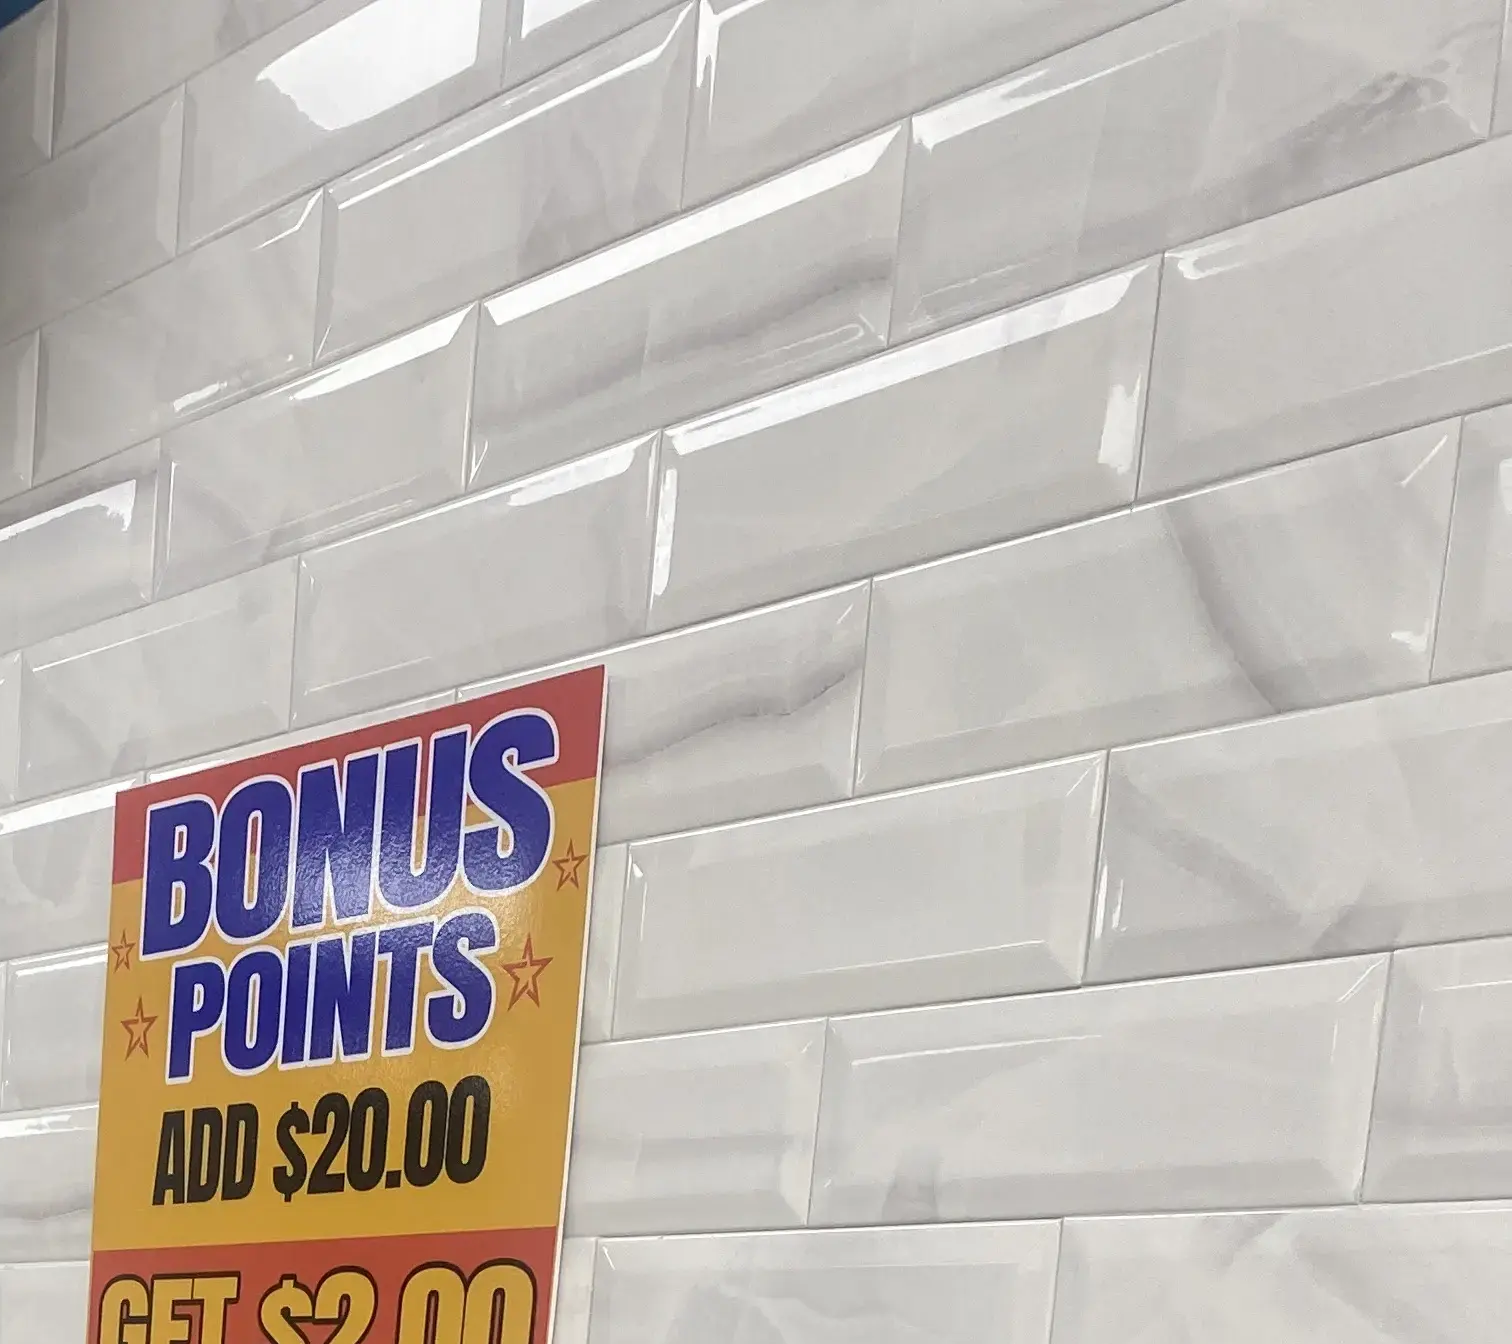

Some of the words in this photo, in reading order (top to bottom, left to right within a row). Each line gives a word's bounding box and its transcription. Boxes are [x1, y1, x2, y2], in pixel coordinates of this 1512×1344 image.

[140, 708, 560, 961] BONUS
[165, 909, 499, 1084] POINTS
[153, 1105, 259, 1206] ADD
[273, 1075, 490, 1203] $20.00
